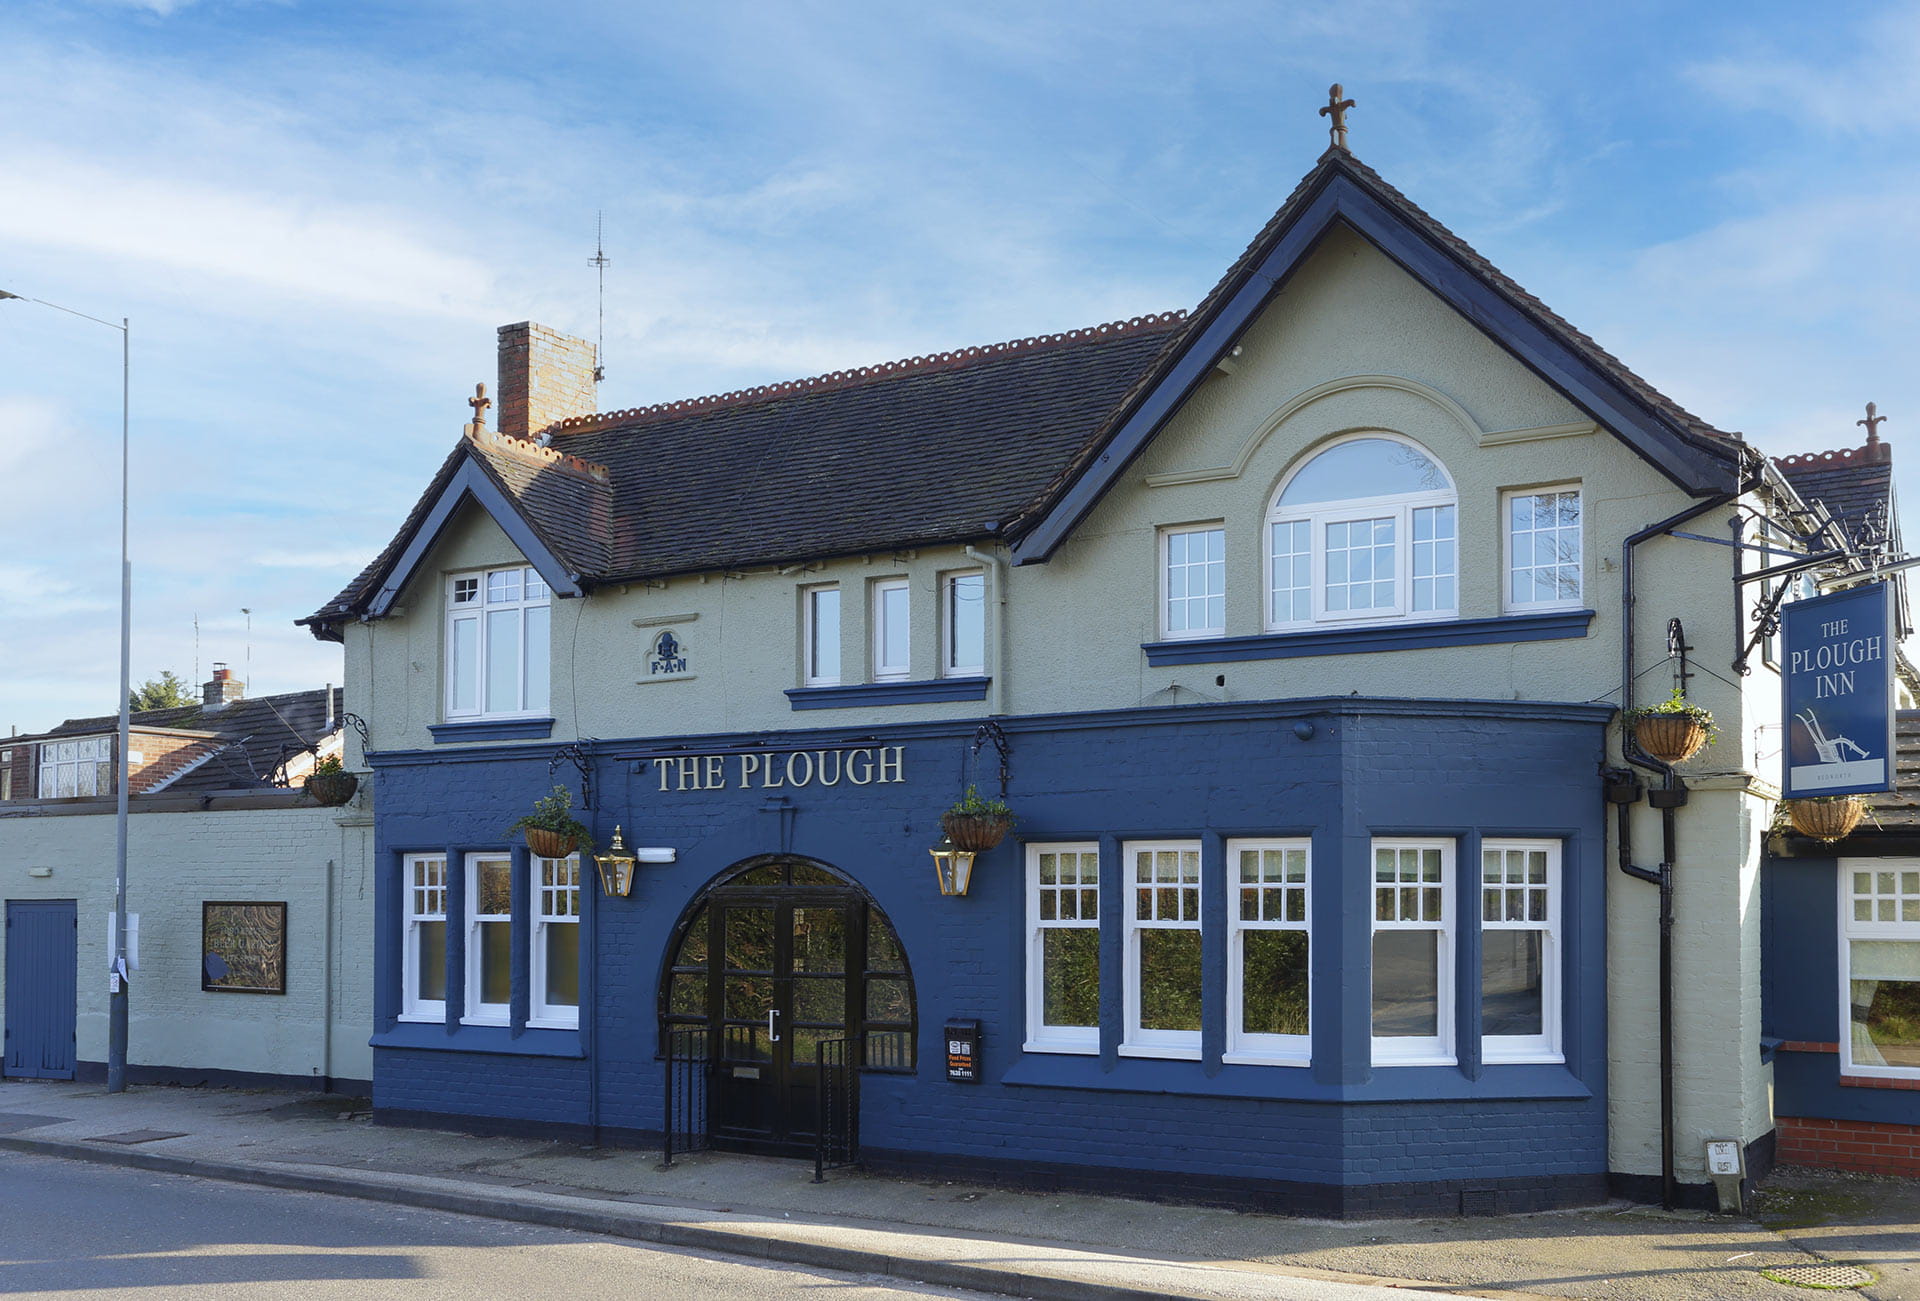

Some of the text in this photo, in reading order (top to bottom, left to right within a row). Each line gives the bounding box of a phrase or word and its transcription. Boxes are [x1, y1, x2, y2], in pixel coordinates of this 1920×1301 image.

[1821, 619, 1848, 638] THE
[1791, 635, 1882, 674] PLOUGH
[1815, 670, 1855, 699] INN
[653, 746, 906, 791] THE PLOUGH
